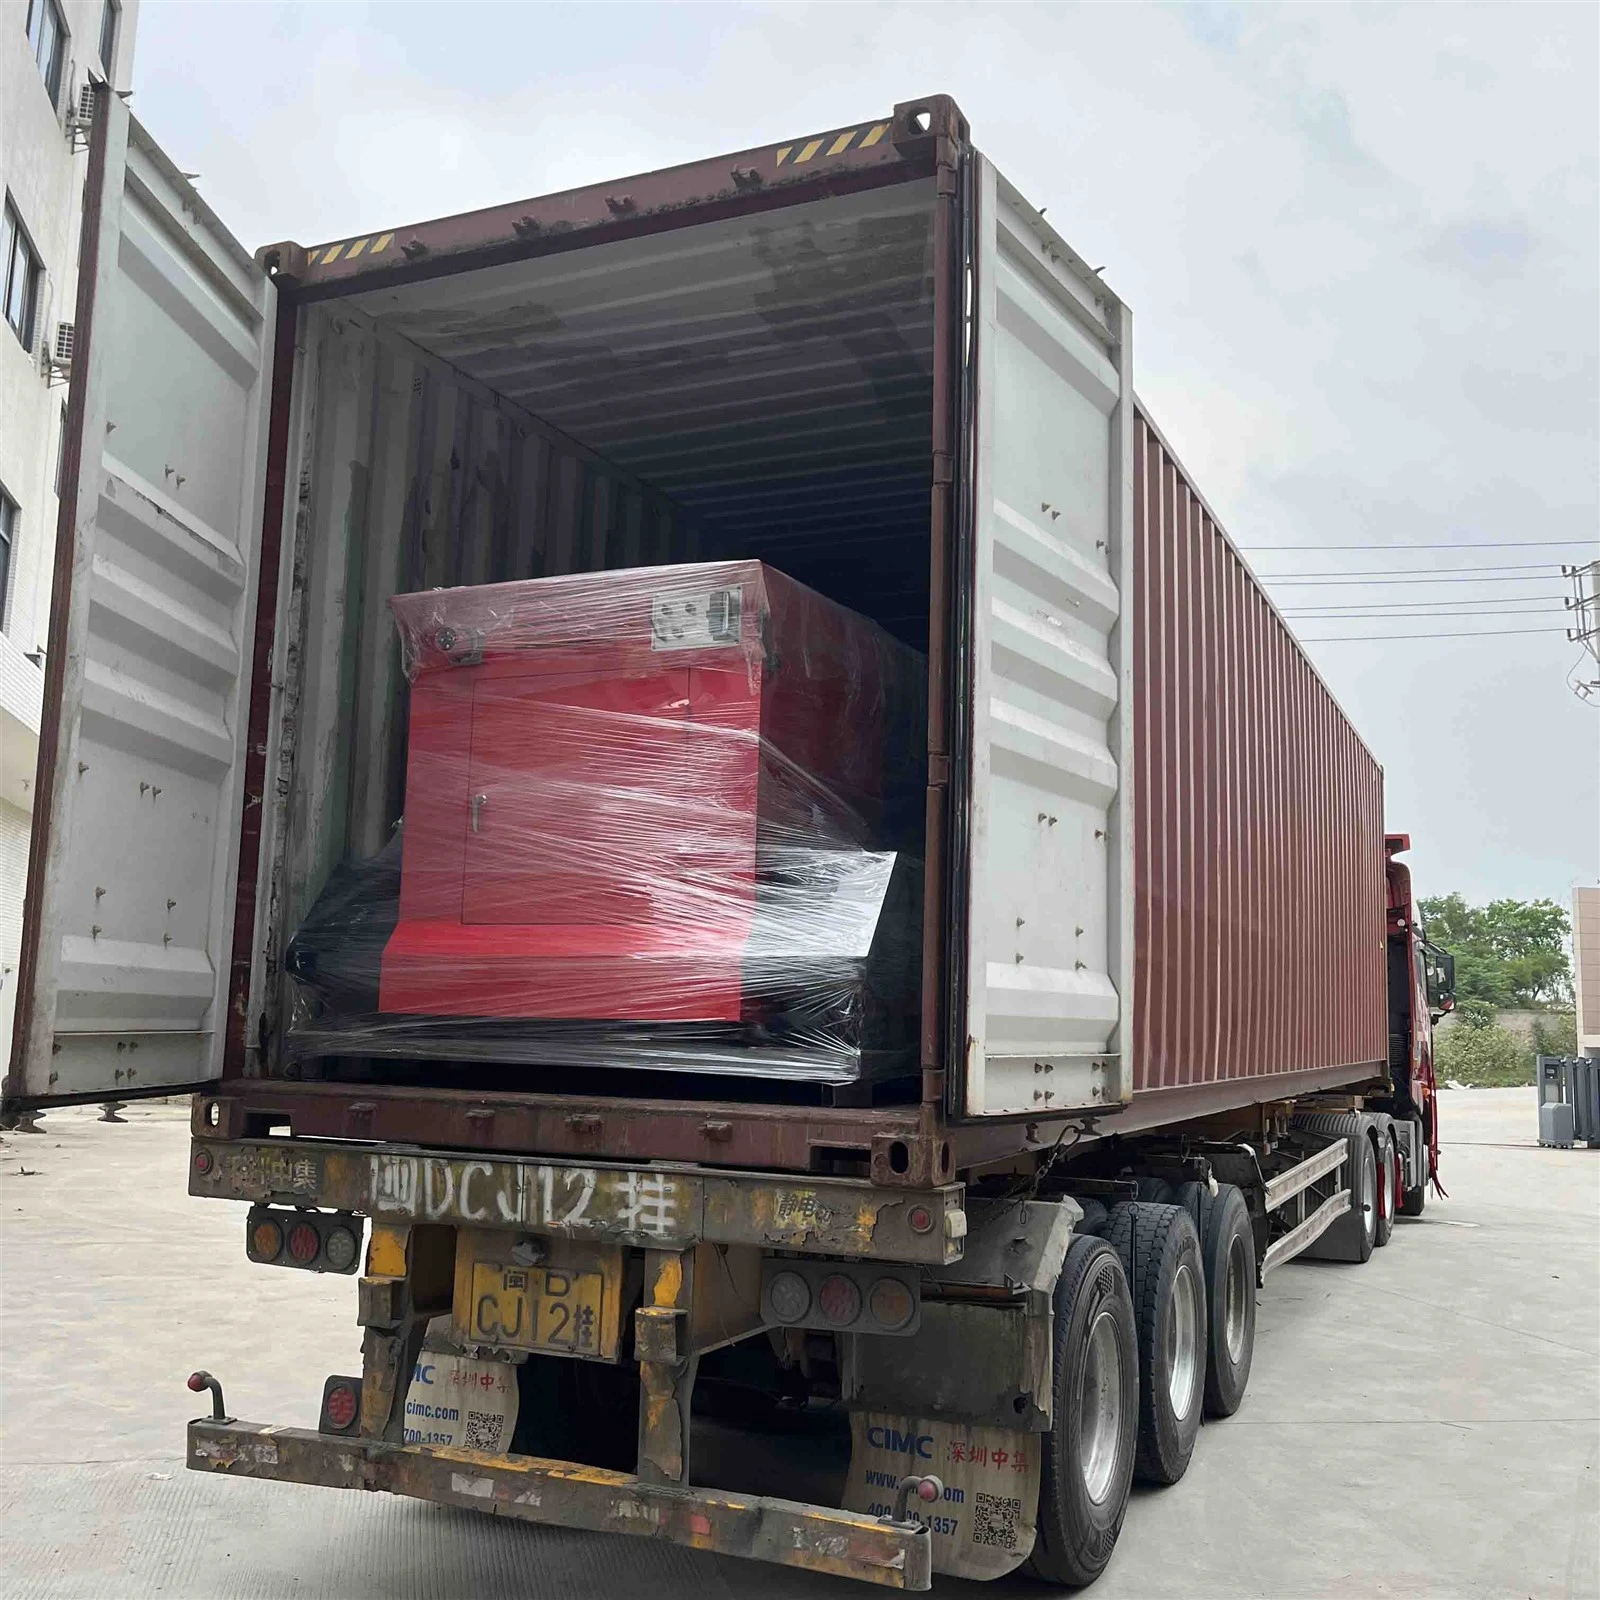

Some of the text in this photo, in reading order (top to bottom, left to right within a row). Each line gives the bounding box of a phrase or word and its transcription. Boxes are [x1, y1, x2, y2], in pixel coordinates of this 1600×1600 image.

[866, 1426, 934, 1459] CIMC
[946, 1439, 1029, 1474] 深圳中集
